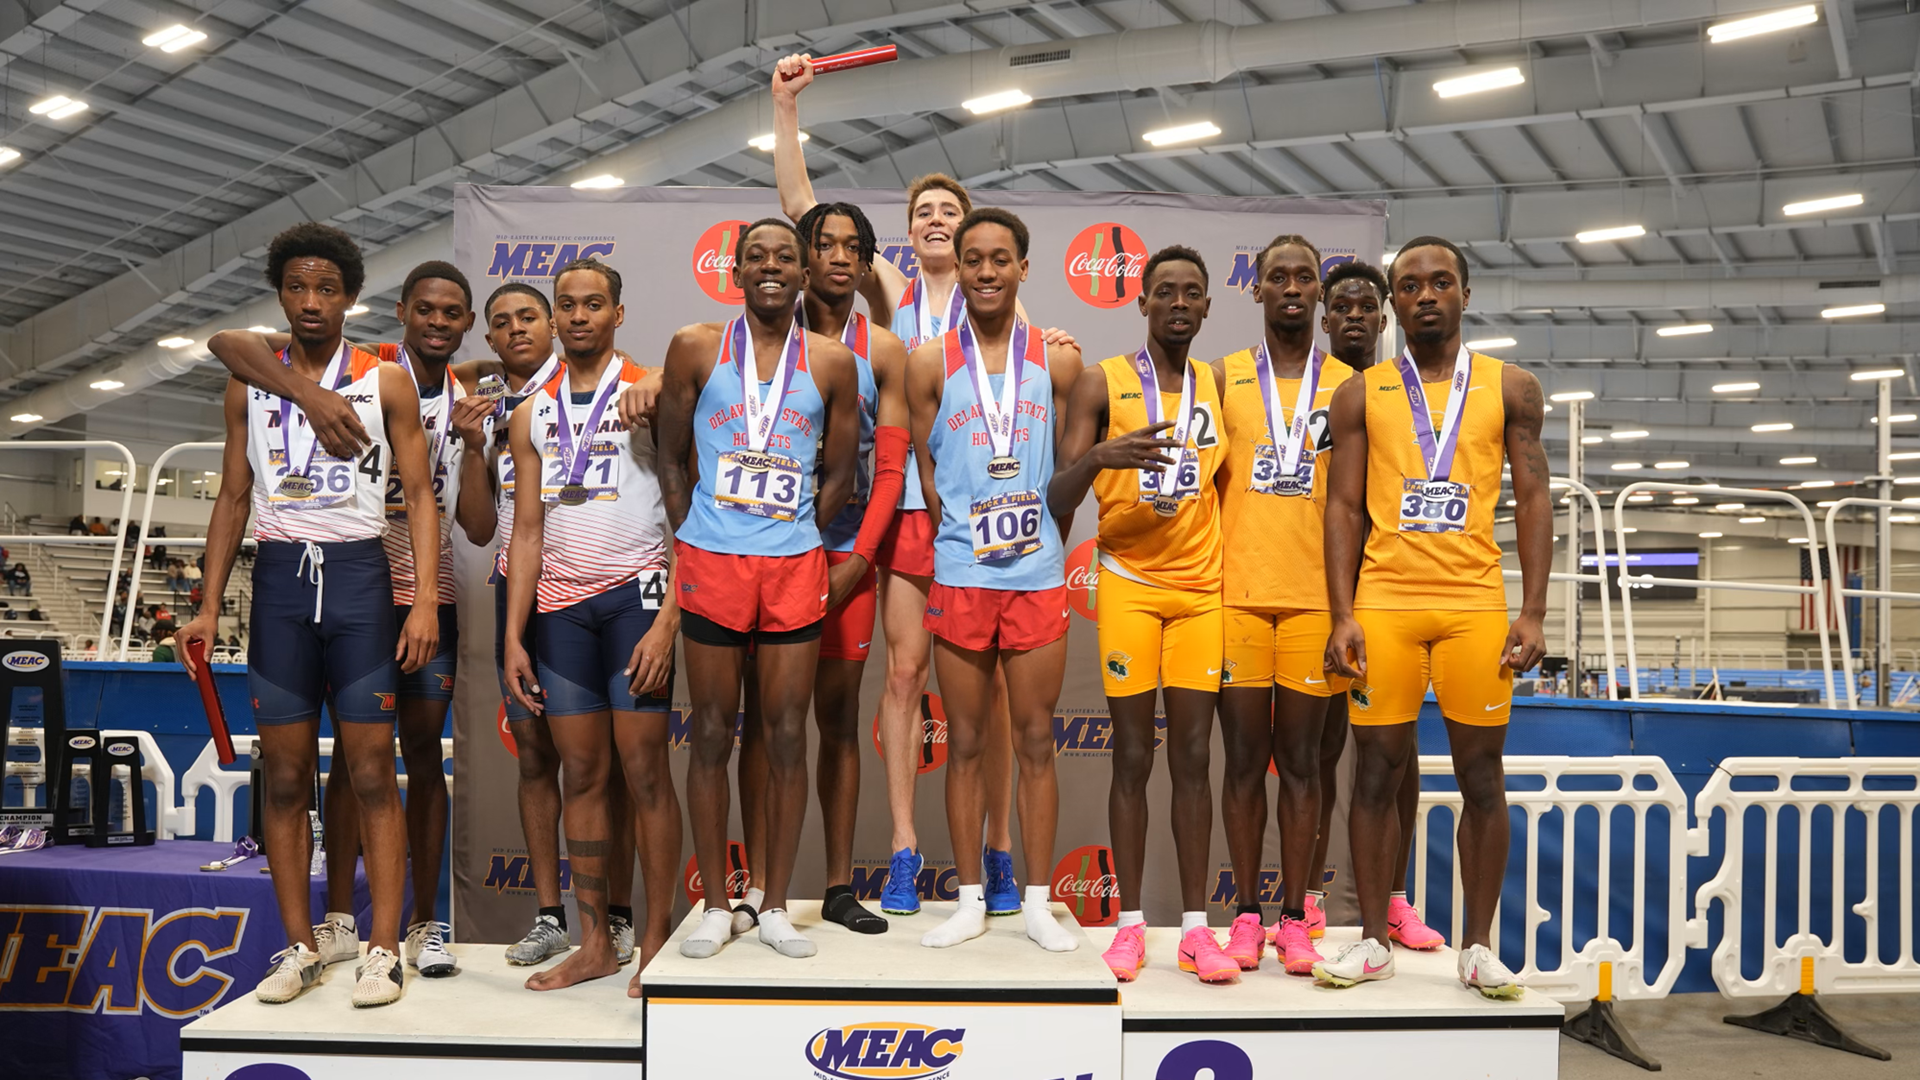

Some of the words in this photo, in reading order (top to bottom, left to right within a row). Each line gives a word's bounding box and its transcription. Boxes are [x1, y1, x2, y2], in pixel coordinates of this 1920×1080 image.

[1068, 251, 1147, 278] Coca-Cola
[1235, 377, 1257, 385] MEAC
[1378, 384, 1402, 392] MEAC
[1120, 392, 1143, 400] MEAC
[782, 407, 813, 437] STATE
[1192, 406, 1216, 447] 2
[1309, 409, 1334, 451] 2
[359, 443, 382, 484] 4
[740, 455, 772, 468] MEAC
[988, 461, 1021, 473] MEAC
[724, 465, 797, 504] 113
[1142, 464, 1197, 489] 36
[1276, 480, 1304, 490] MEAC
[281, 481, 314, 492] MEAC
[1425, 485, 1456, 496] MEAC
[972, 500, 999, 513] TRACK
[1011, 494, 1037, 502] FIELD
[1156, 500, 1179, 511] MEAC
[1402, 494, 1466, 522] 380
[975, 508, 1039, 546] 106
[642, 571, 666, 608] 4
[7, 656, 46, 668] MEAC
[111, 745, 133, 753] MEAC
[817, 1027, 966, 1071] MEAC
